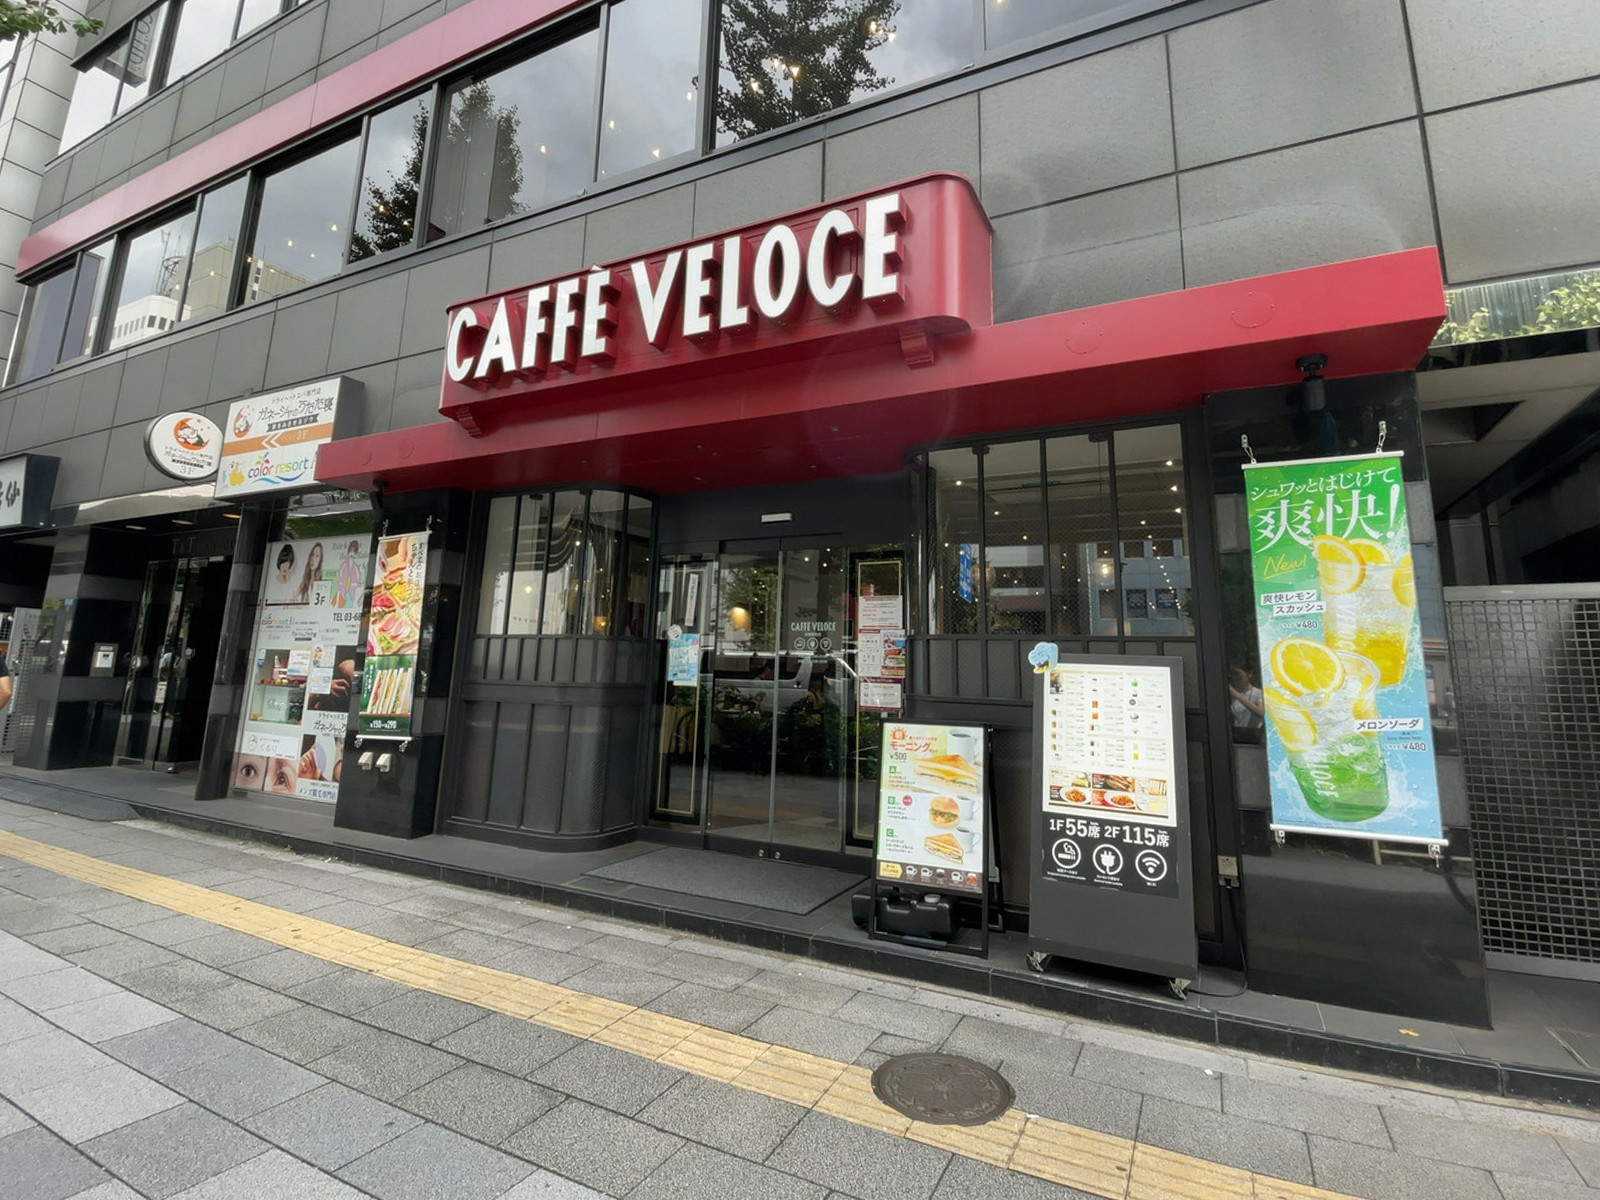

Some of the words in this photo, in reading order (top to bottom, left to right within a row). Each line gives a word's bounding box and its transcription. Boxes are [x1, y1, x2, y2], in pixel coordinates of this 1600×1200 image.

[447, 264, 611, 384] CAFFÈ
[630, 193, 900, 346] VELOCE
[248, 463, 274, 478] color
[275, 457, 309, 474] resort
[1250, 466, 1397, 501] シュワッとはじけて
[314, 592, 326, 606] 3F
[1263, 591, 1316, 604] 爽快レモン
[1275, 603, 1324, 615] スカッシュ
[333, 612, 343, 622] TEL
[811, 621, 836, 632] VELOCE
[1356, 719, 1420, 730] メロンソーダ
[890, 741, 931, 752] モーニング
